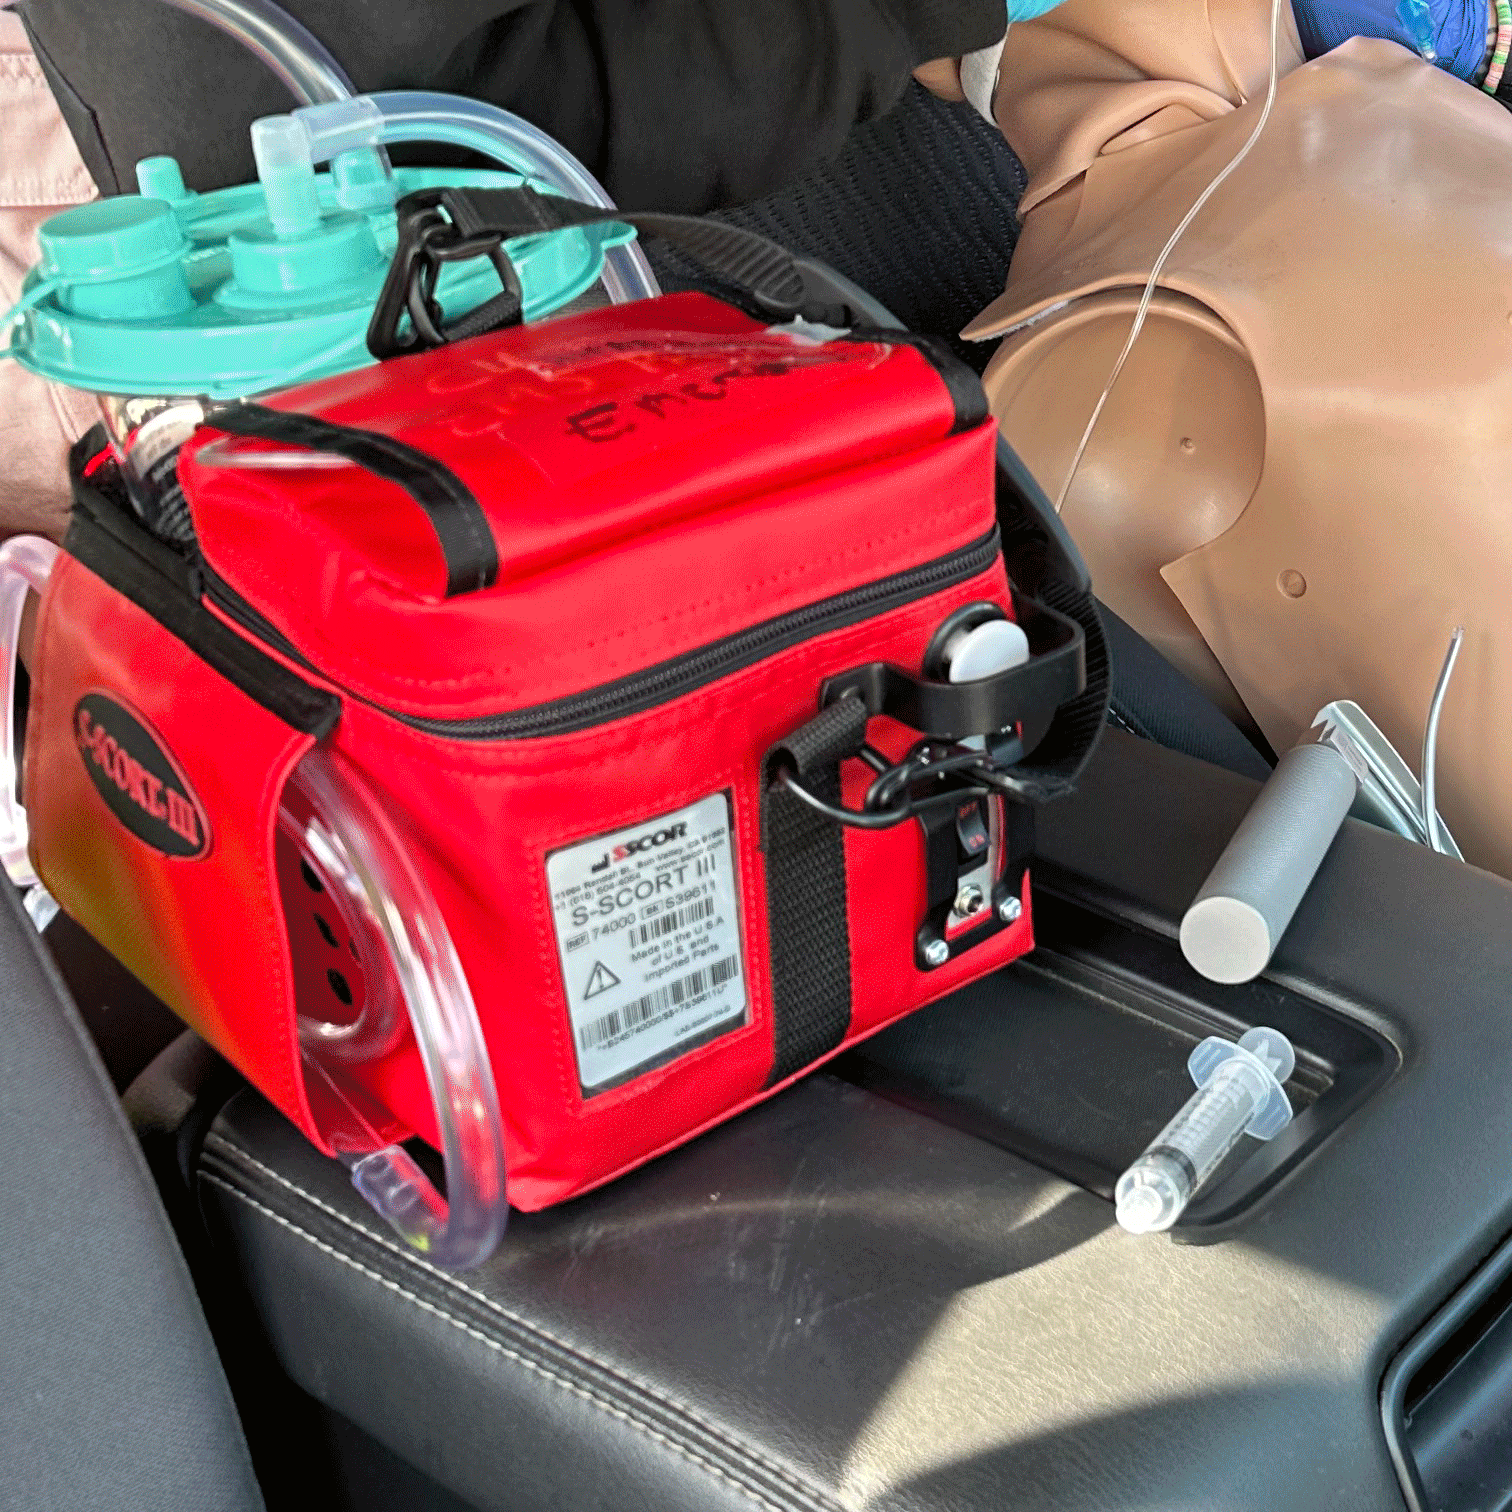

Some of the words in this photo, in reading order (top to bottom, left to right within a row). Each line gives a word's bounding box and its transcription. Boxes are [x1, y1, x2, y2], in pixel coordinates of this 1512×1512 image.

[612, 821, 688, 863] SSCOR
[572, 864, 688, 926] S-SCORT
[697, 853, 717, 877] III
[592, 912, 637, 940] 74000
[630, 944, 661, 963] Made
[662, 938, 673, 949] in
[673, 930, 692, 944] the
[644, 955, 690, 983] Imported
[691, 942, 721, 960] Parts
[651, 953, 662, 967] of
[688, 934, 710, 949] and
